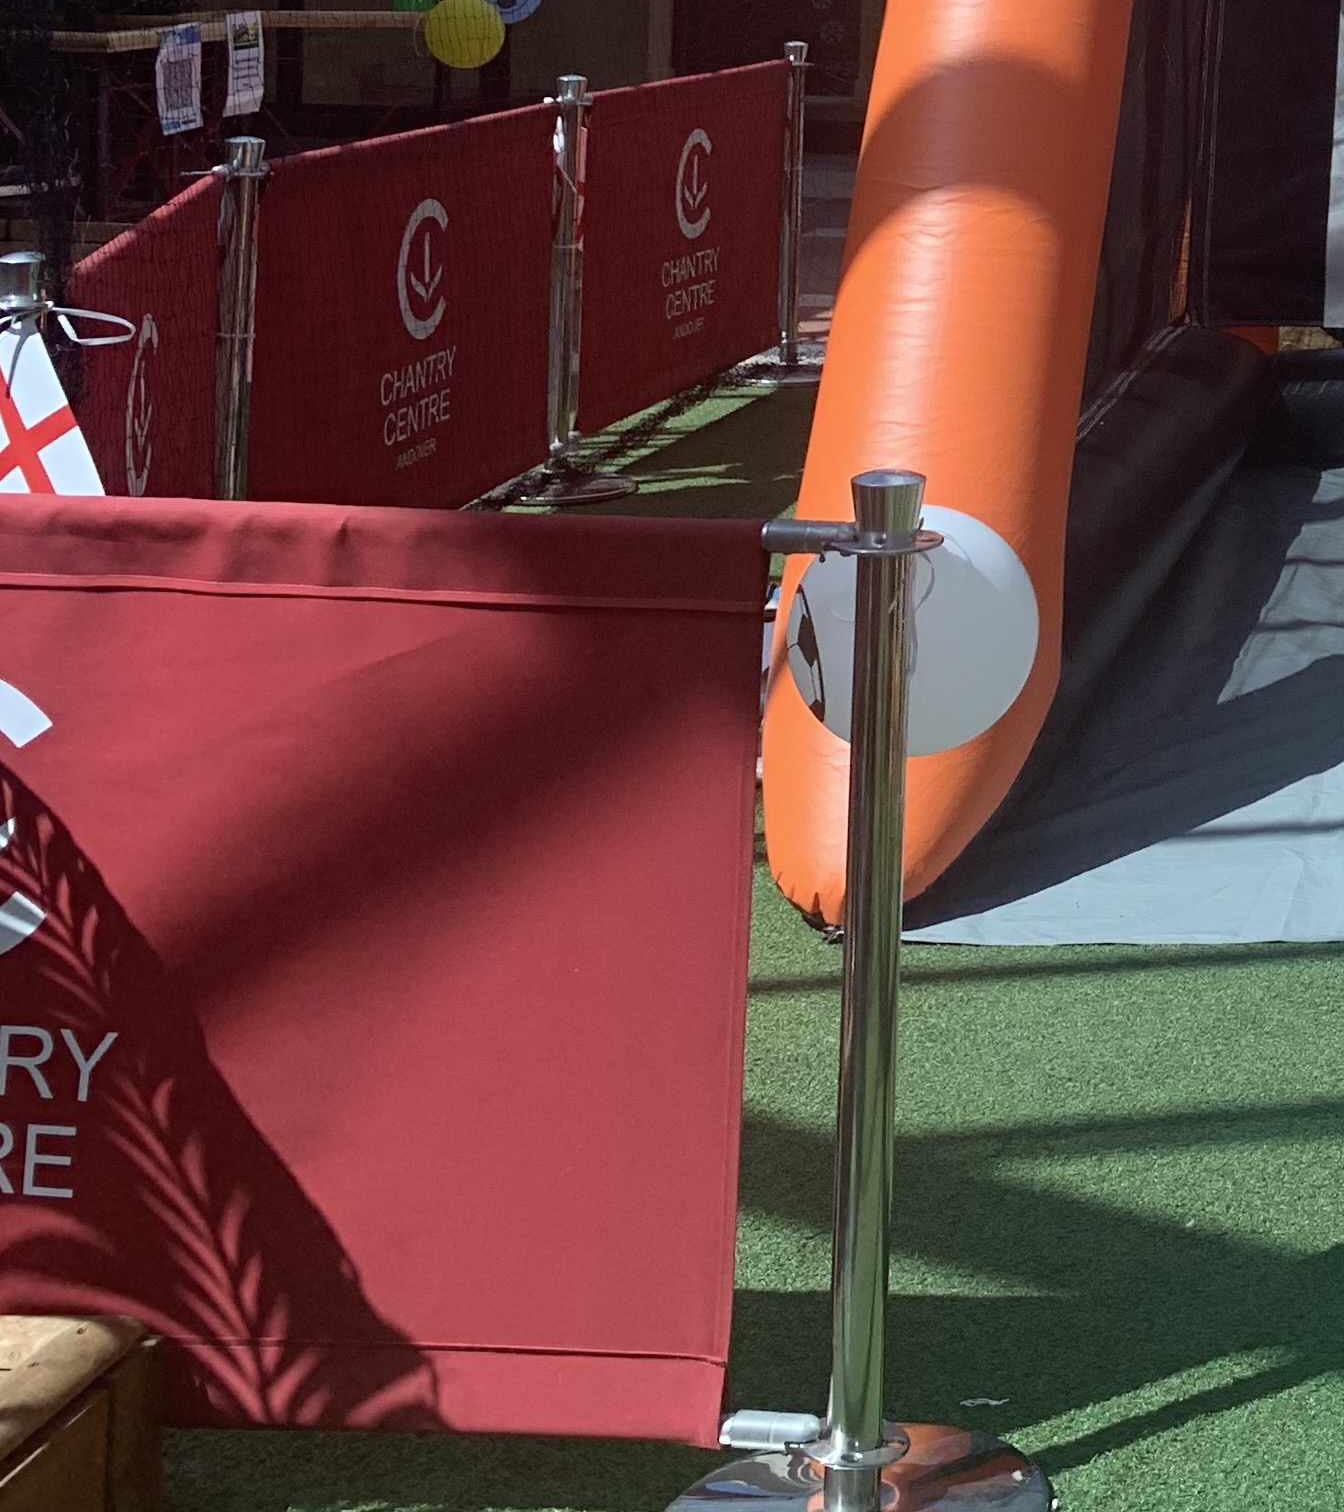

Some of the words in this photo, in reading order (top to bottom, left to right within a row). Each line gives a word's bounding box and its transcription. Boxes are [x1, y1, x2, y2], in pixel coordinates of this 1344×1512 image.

[662, 246, 720, 288] CHANTRY
[665, 279, 716, 320] CENTRE
[380, 345, 457, 406] CHANTRY
[383, 388, 451, 446] CENTRE
